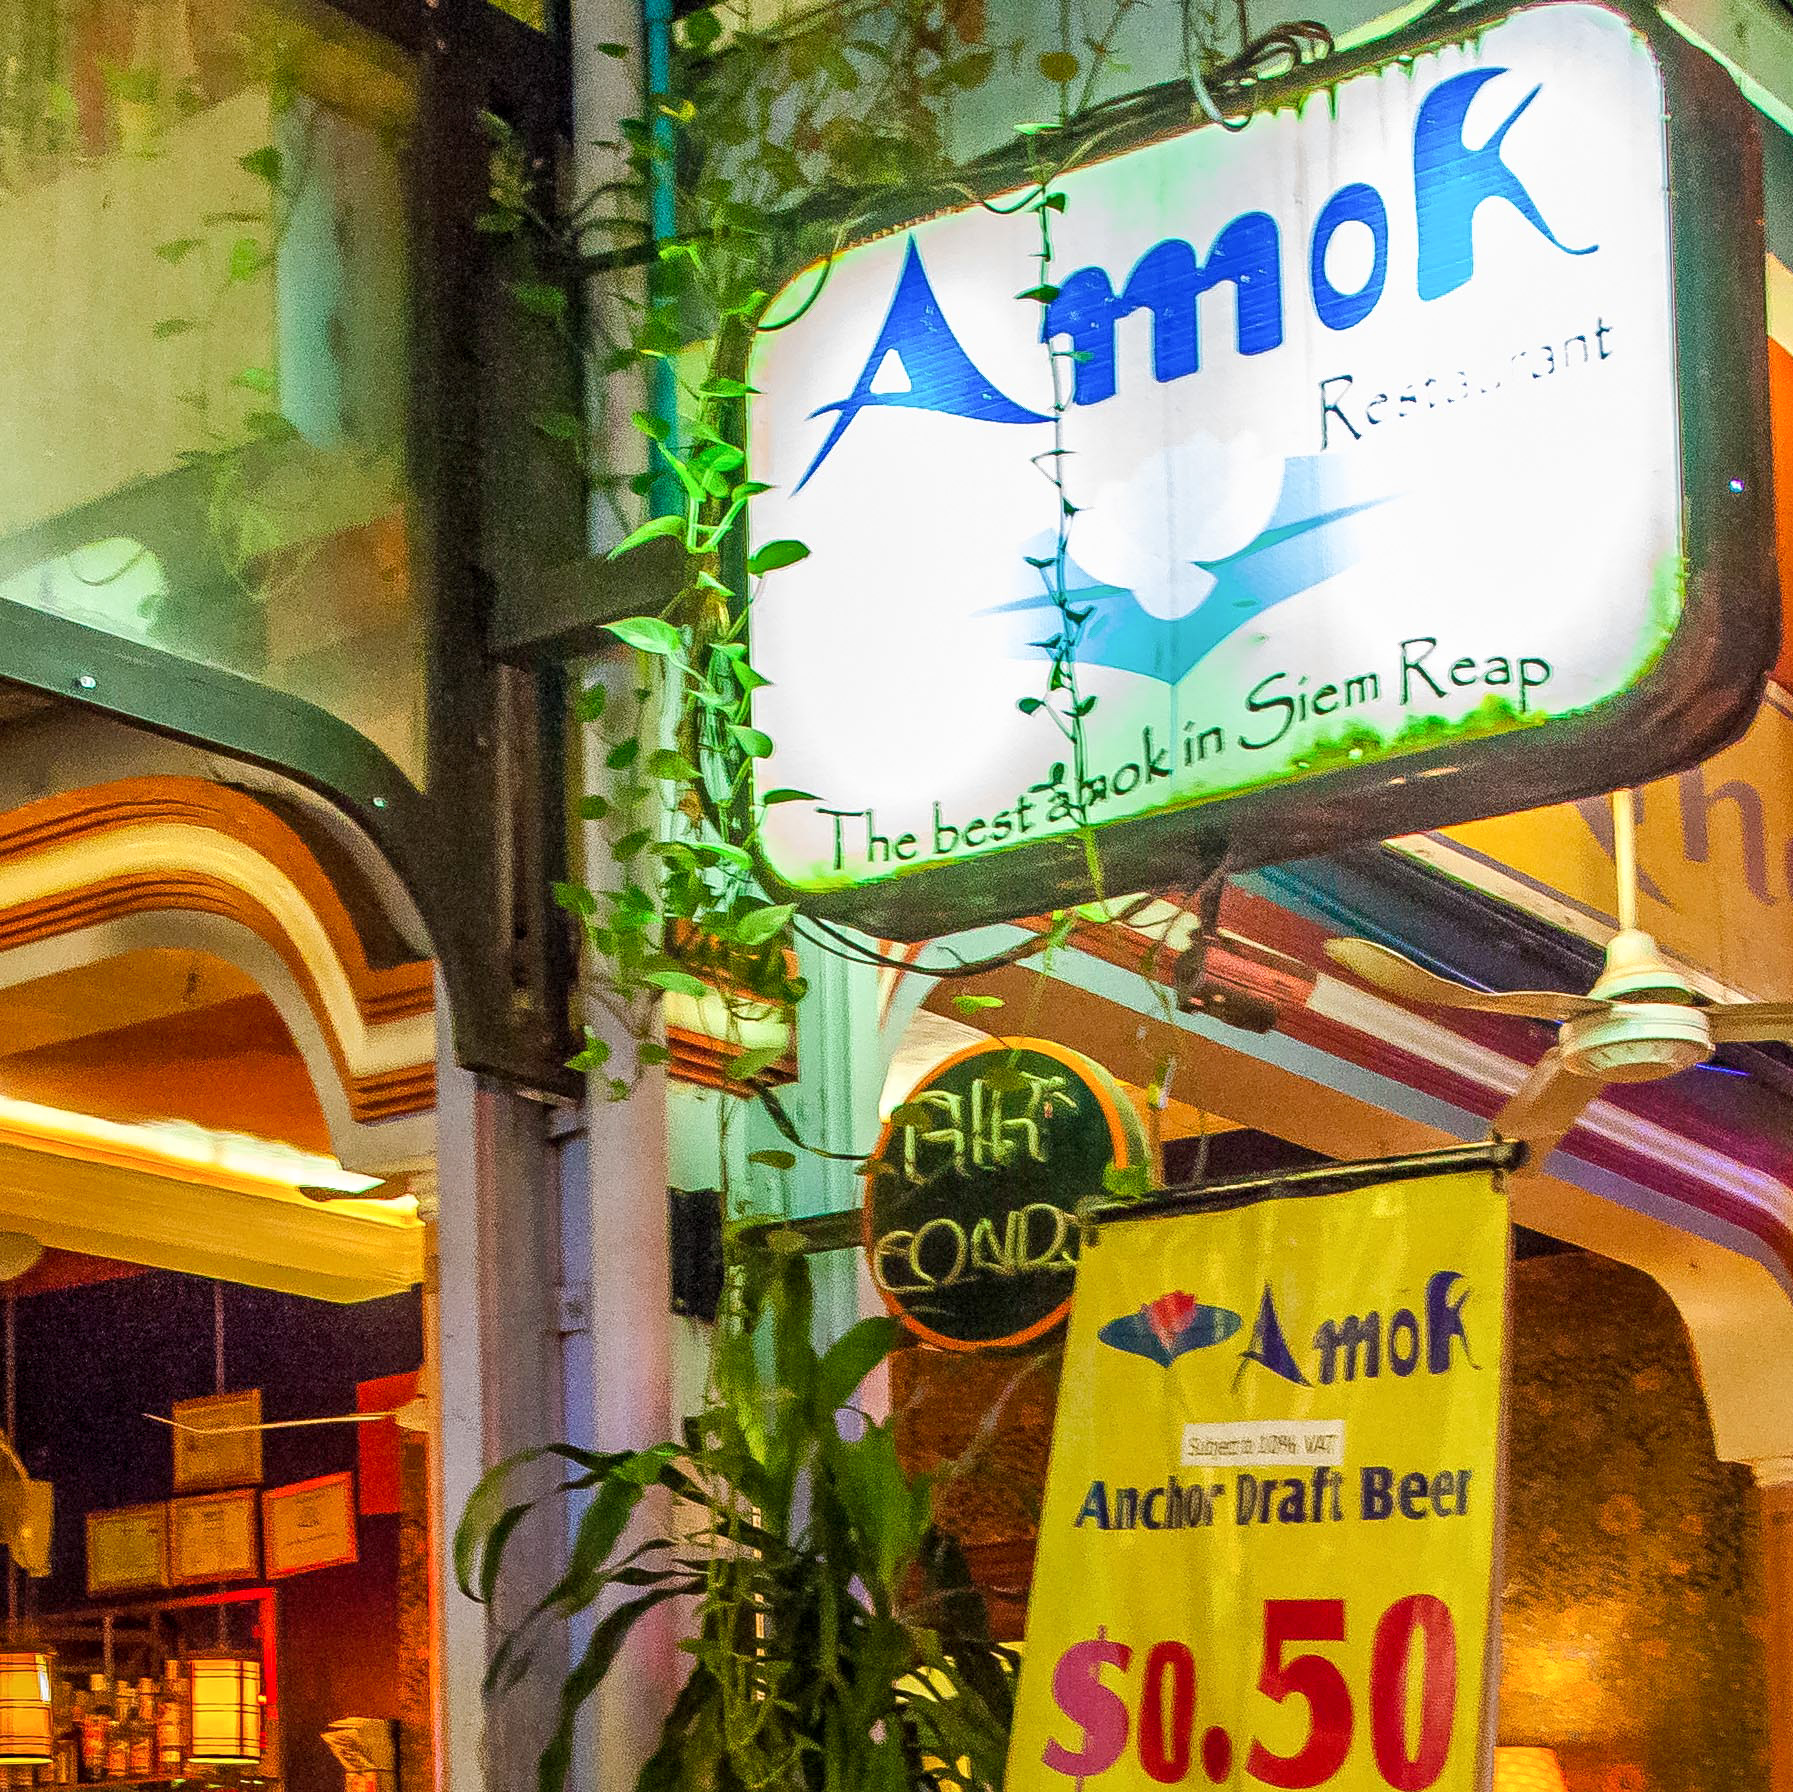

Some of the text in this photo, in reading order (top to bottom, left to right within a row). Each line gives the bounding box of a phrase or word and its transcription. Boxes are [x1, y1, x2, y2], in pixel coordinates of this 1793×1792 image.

[1318, 316, 1613, 452] Restaant
[815, 805, 917, 871] The
[931, 795, 1036, 856] best
[1183, 720, 1225, 767] in
[1238, 671, 1380, 751] Siem
[1398, 636, 1554, 712] Reap
[1072, 1465, 1474, 1531] Anchor Draft Beer
